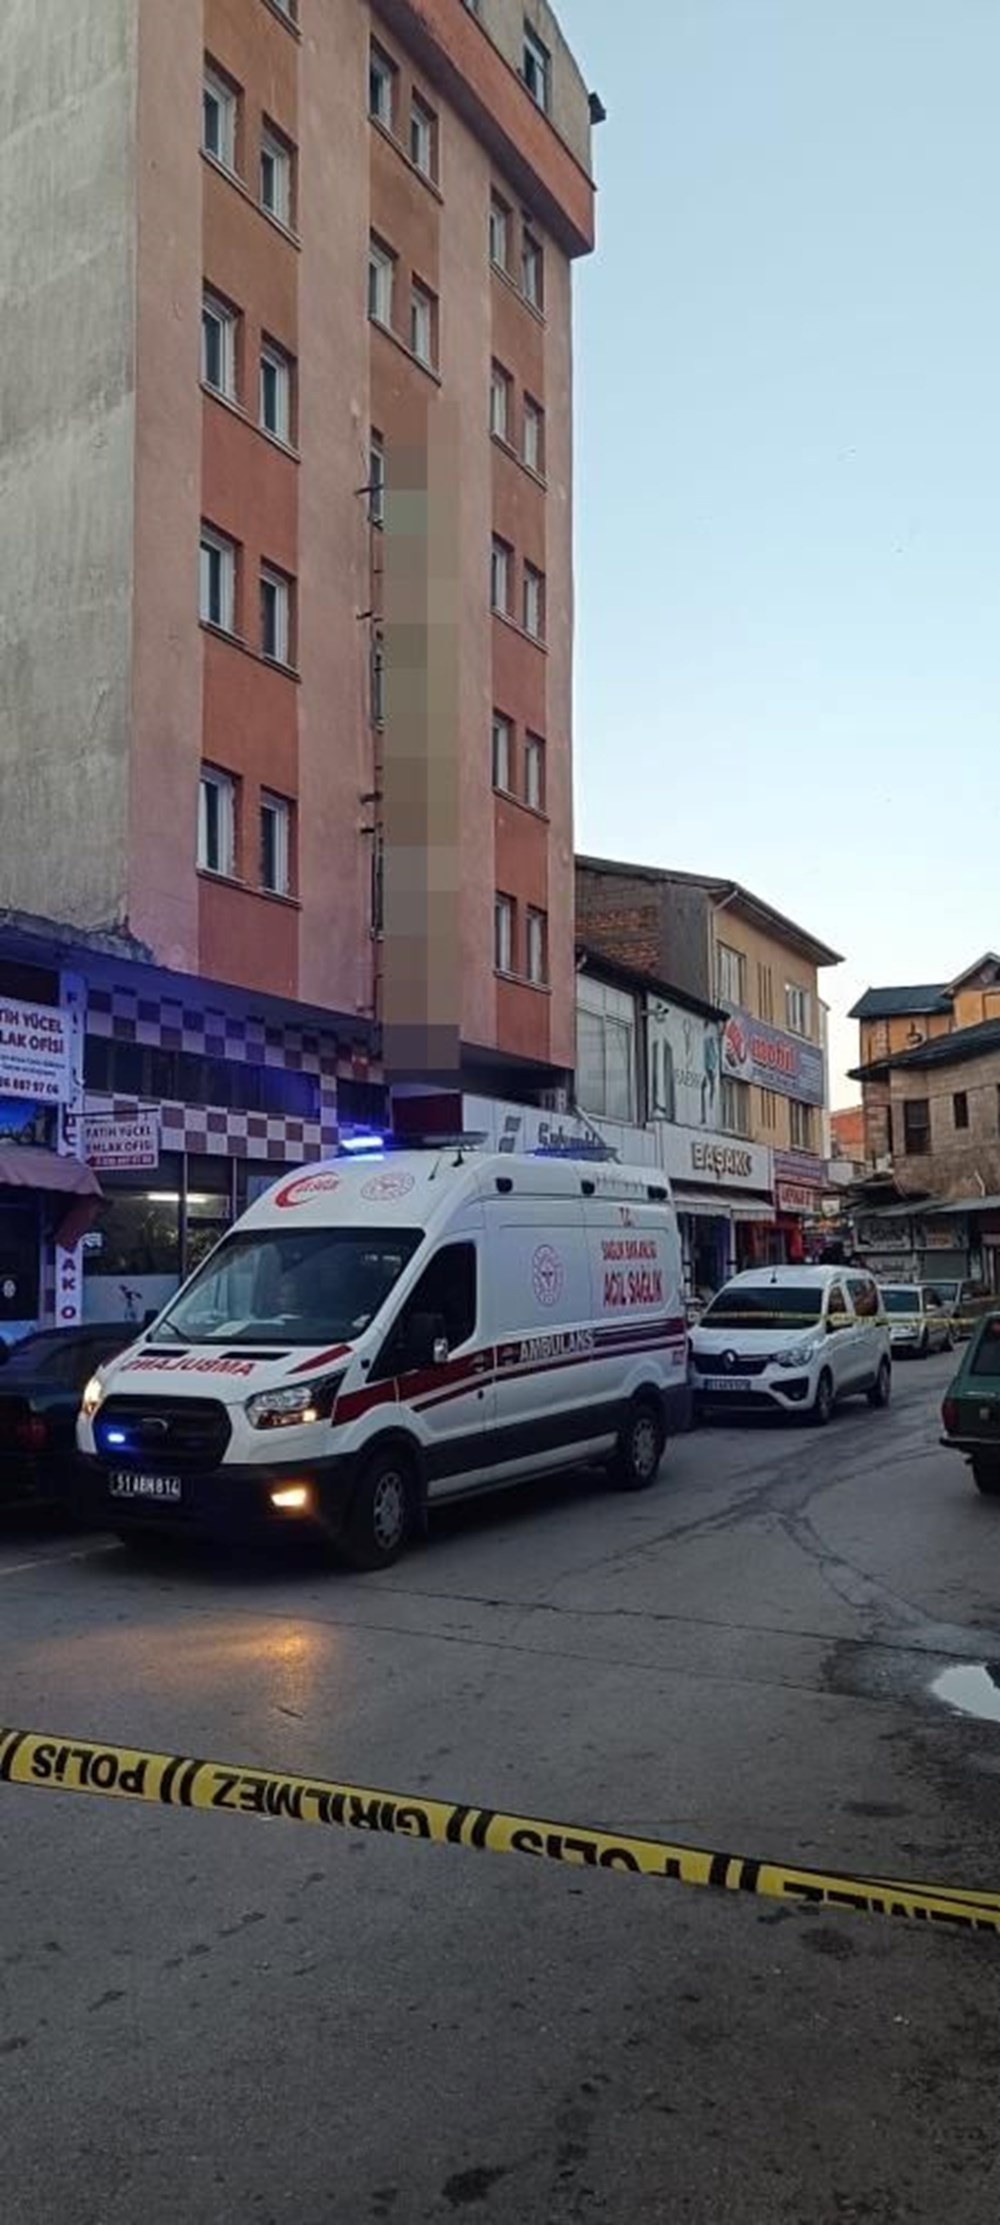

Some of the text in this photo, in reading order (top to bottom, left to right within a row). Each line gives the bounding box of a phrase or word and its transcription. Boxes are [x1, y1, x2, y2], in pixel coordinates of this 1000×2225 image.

[22, 1012, 63, 1034] YÜCEL
[519, 1329, 594, 1363] AMBULANS
[31, 1743, 149, 1794] POLİS
